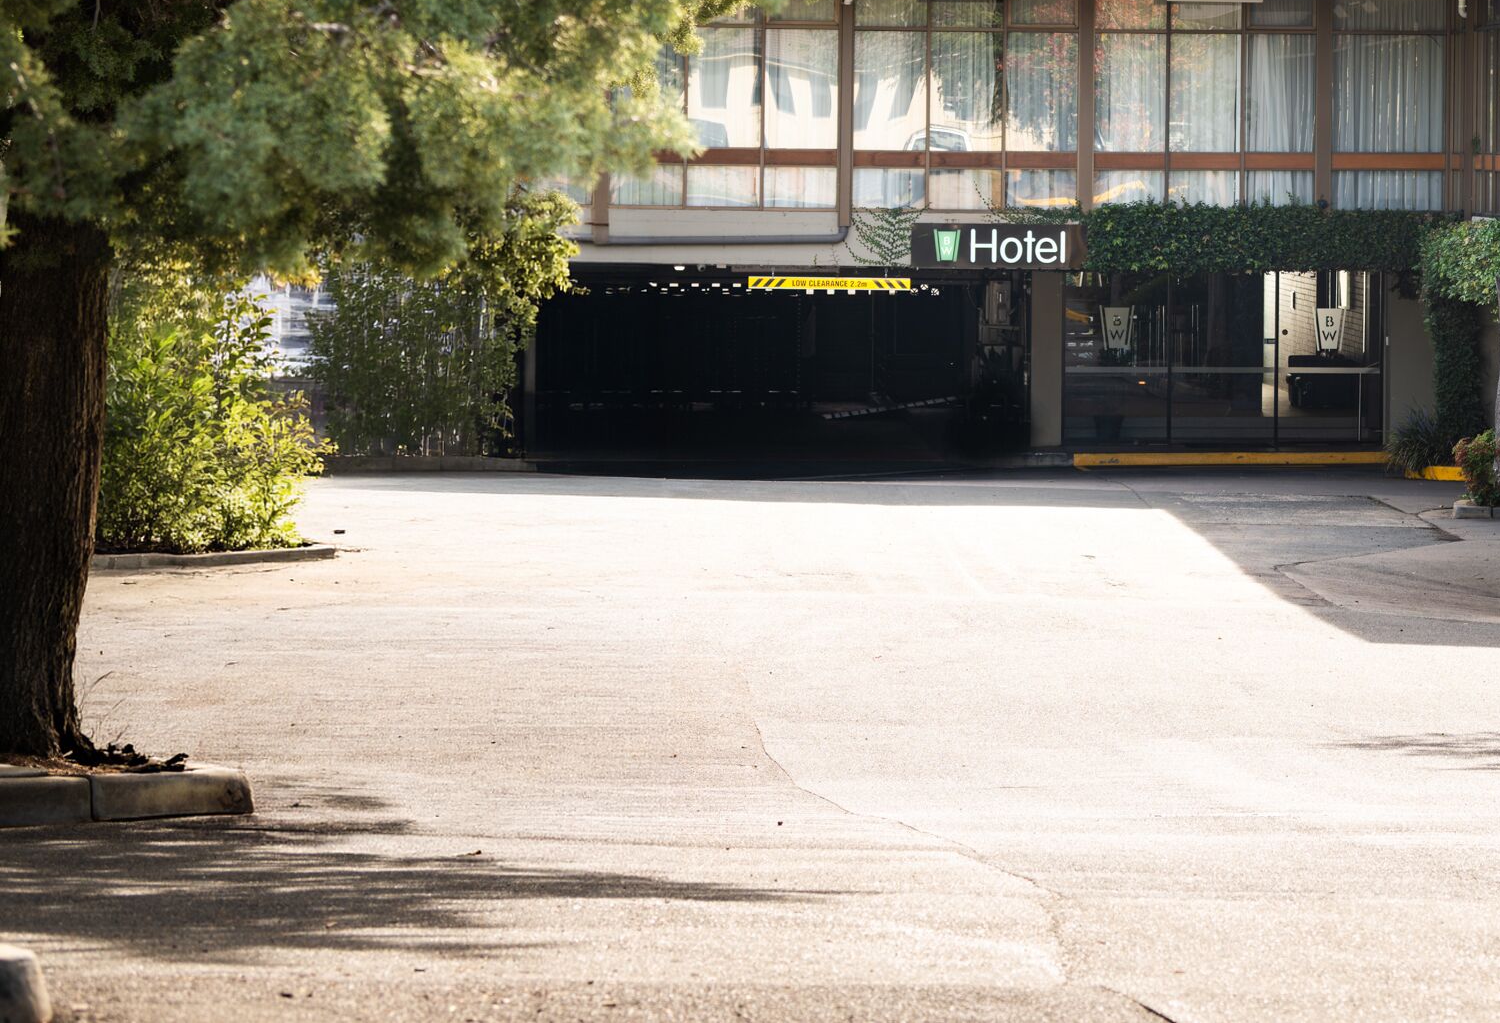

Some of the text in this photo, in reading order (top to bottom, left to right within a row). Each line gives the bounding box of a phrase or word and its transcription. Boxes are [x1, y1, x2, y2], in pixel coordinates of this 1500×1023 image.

[970, 228, 1066, 264] Hotel
[791, 279, 868, 288] LOW CLEARANCE 2.2m
